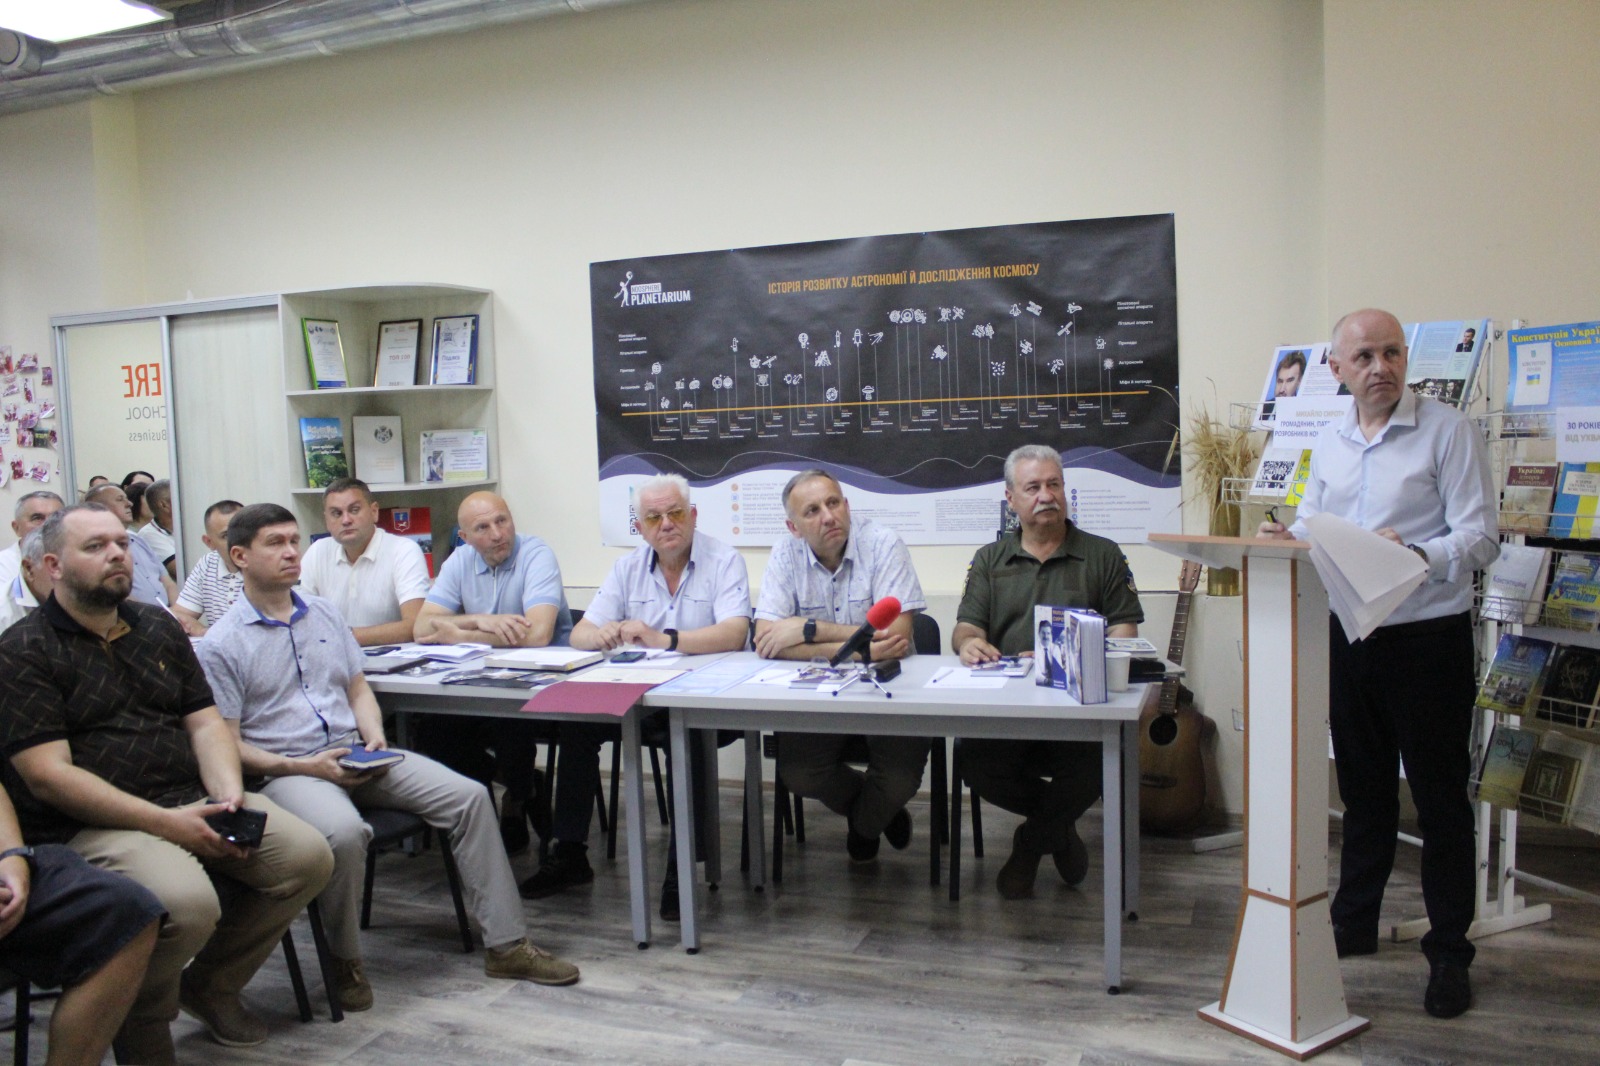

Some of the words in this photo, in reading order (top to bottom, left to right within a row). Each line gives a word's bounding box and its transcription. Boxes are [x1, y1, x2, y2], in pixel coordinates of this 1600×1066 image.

[768, 281, 801, 294] ІСТОРІЯ
[803, 277, 849, 292] РОЗВИТКУ
[851, 270, 908, 288] АСТРОНОМІЇ
[909, 270, 917, 285] Й
[918, 267, 991, 284] ДОСЛІДЖЕННЯ
[993, 263, 1040, 280] КОСМОСУ
[631, 290, 691, 306] PLANETARIUM
[1567, 421, 1577, 430] 30
